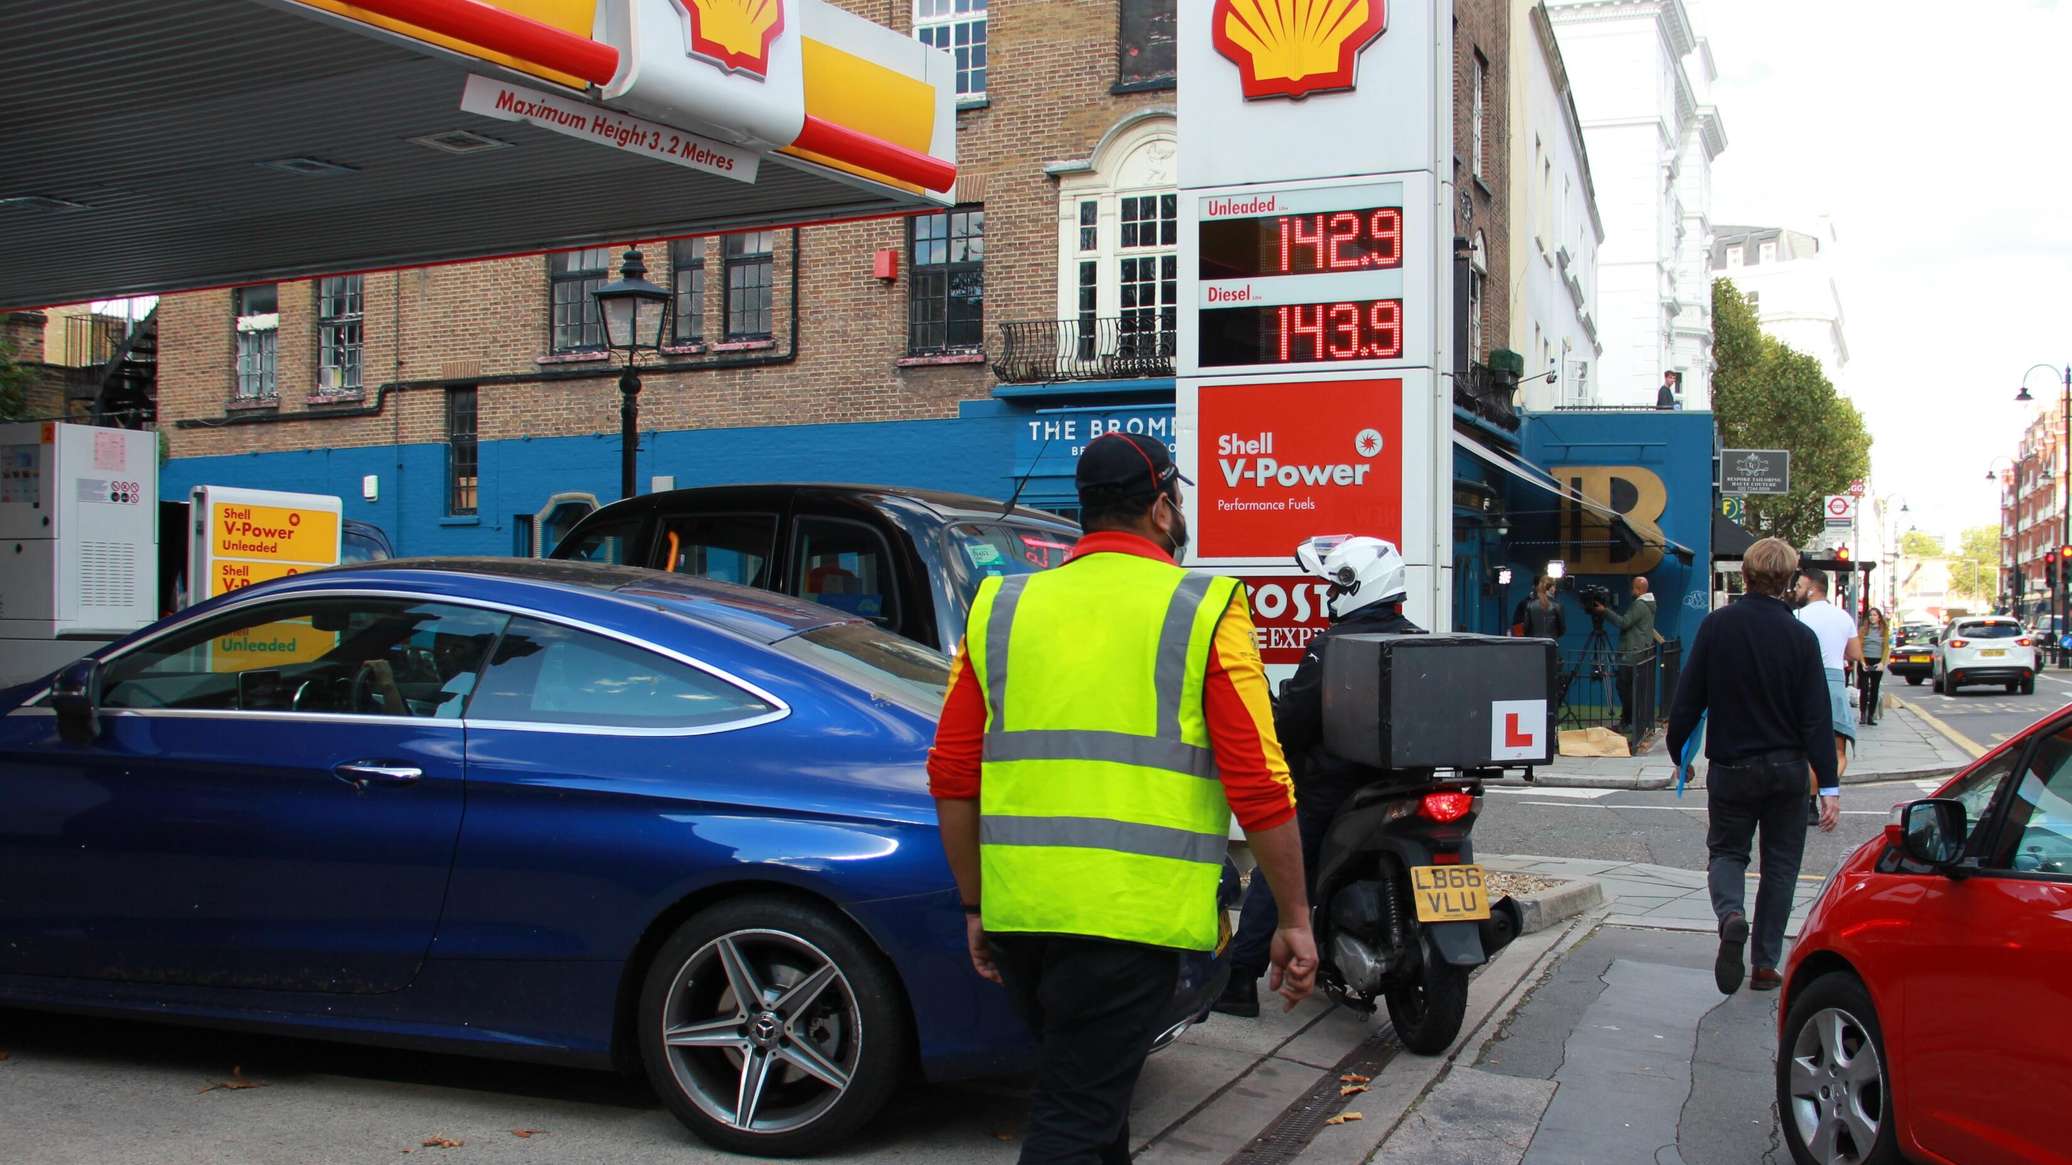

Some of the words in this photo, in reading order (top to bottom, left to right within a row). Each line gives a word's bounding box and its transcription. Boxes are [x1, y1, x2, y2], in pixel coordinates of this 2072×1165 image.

[496, 90, 586, 130] Maximum
[591, 116, 648, 150] Height
[681, 143, 734, 171] Metres
[1208, 196, 1275, 216] Unleaded
[1279, 210, 1400, 271] 142.9
[1208, 285, 1250, 302] Diesel
[1279, 301, 1400, 361] 143.9
[1029, 420, 1076, 441] THE
[1218, 432, 1272, 455] Shell
[1218, 458, 1370, 488] V-Power
[223, 508, 251, 520] Shell
[1218, 498, 1284, 511] Performance
[1288, 497, 1315, 510] Fuels
[224, 521, 294, 539] V-Power
[223, 540, 277, 553] Unleaded
[222, 565, 249, 577] Shell
[222, 637, 297, 652] Unleaded
[1505, 713, 1533, 748] L
[1414, 868, 1481, 890] LB66
[1427, 891, 1477, 913] VLU
